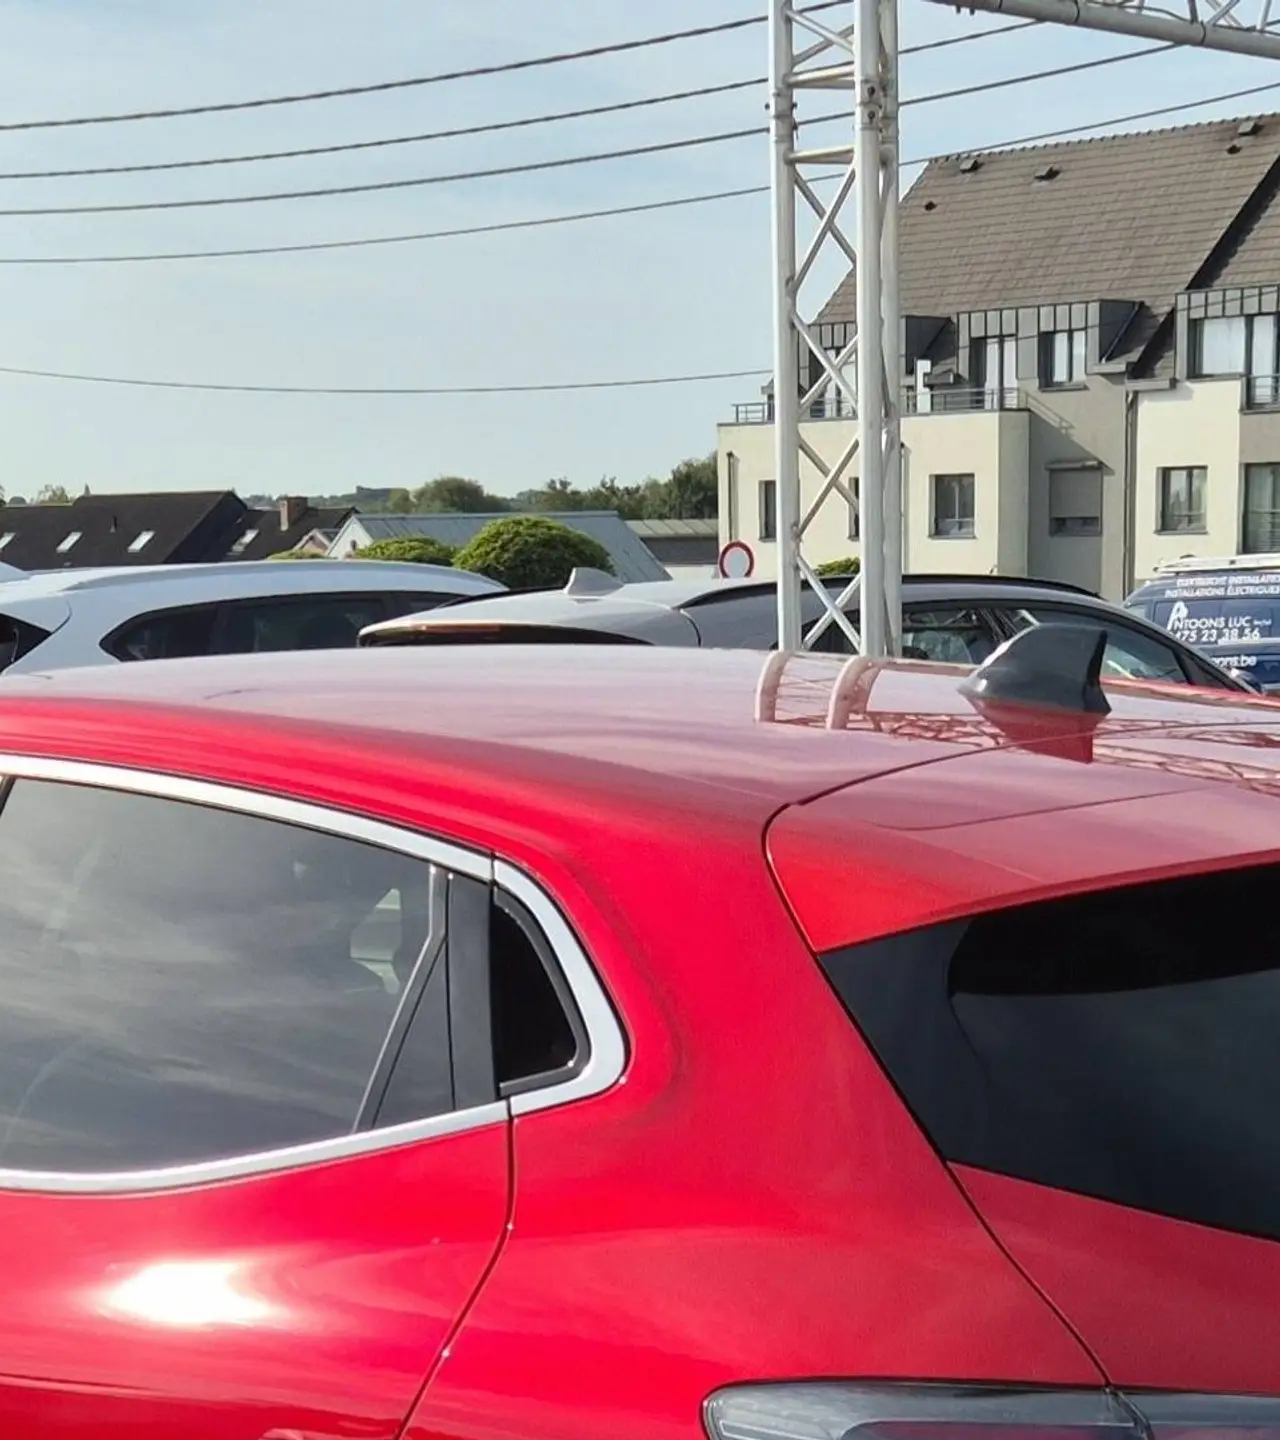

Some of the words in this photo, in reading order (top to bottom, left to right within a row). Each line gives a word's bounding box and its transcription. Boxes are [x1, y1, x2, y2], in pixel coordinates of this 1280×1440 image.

[1228, 616, 1252, 627] LUC
[1200, 630, 1218, 642] 23
[1243, 628, 1261, 640] 56
